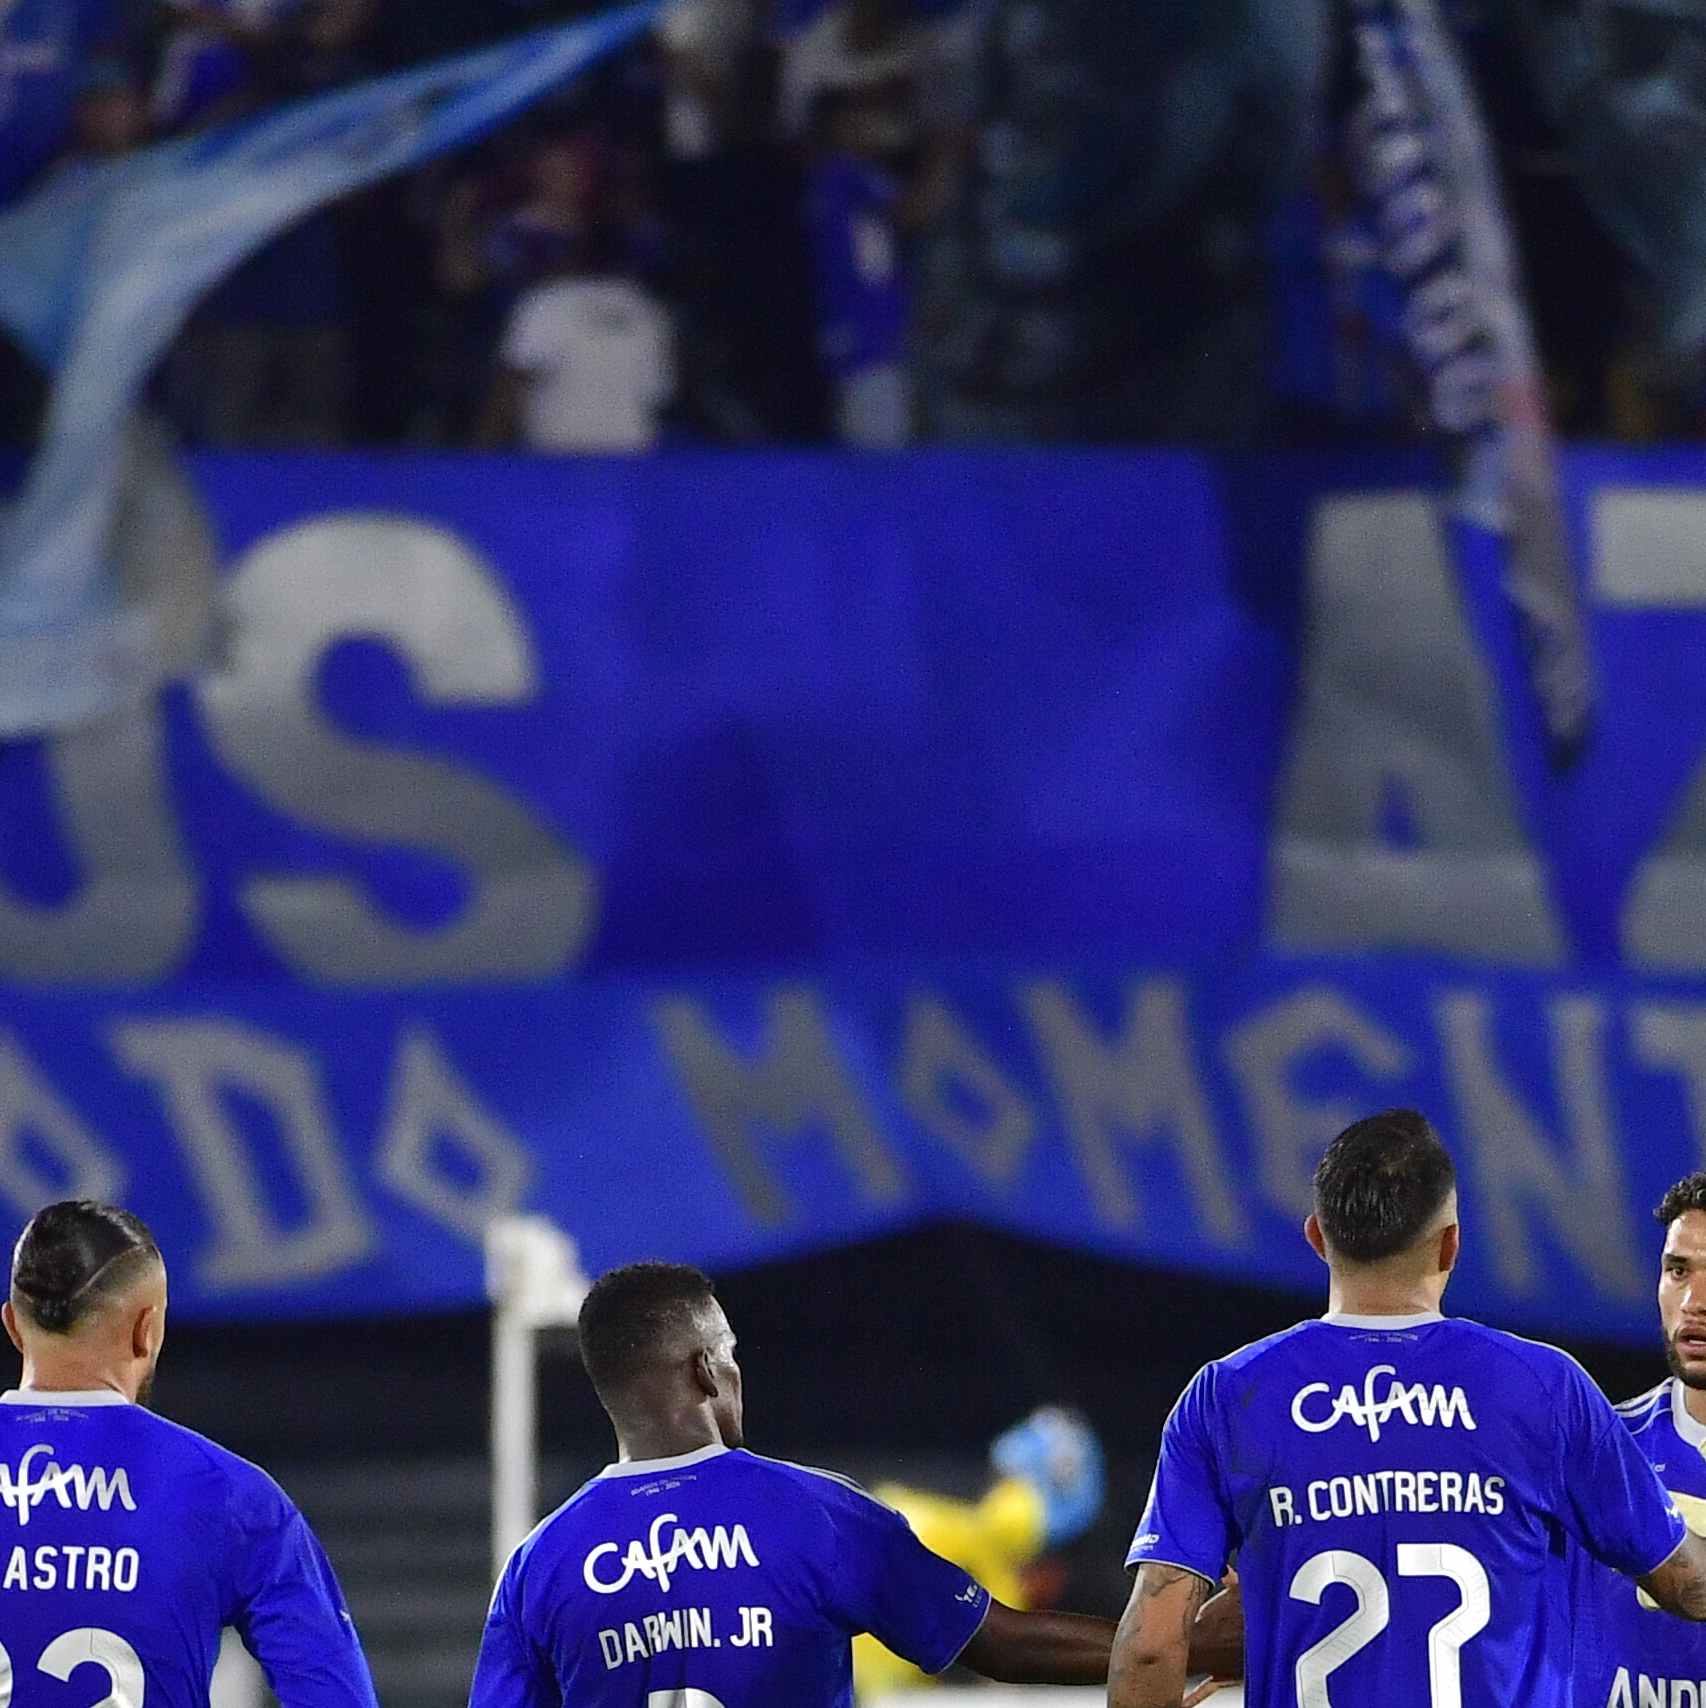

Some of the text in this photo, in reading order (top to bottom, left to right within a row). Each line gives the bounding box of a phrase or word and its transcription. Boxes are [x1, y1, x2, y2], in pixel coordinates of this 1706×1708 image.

[1269, 1470, 1506, 1528] R. CONTRERAS
[598, 1605, 774, 1671] DARWIN. JR
